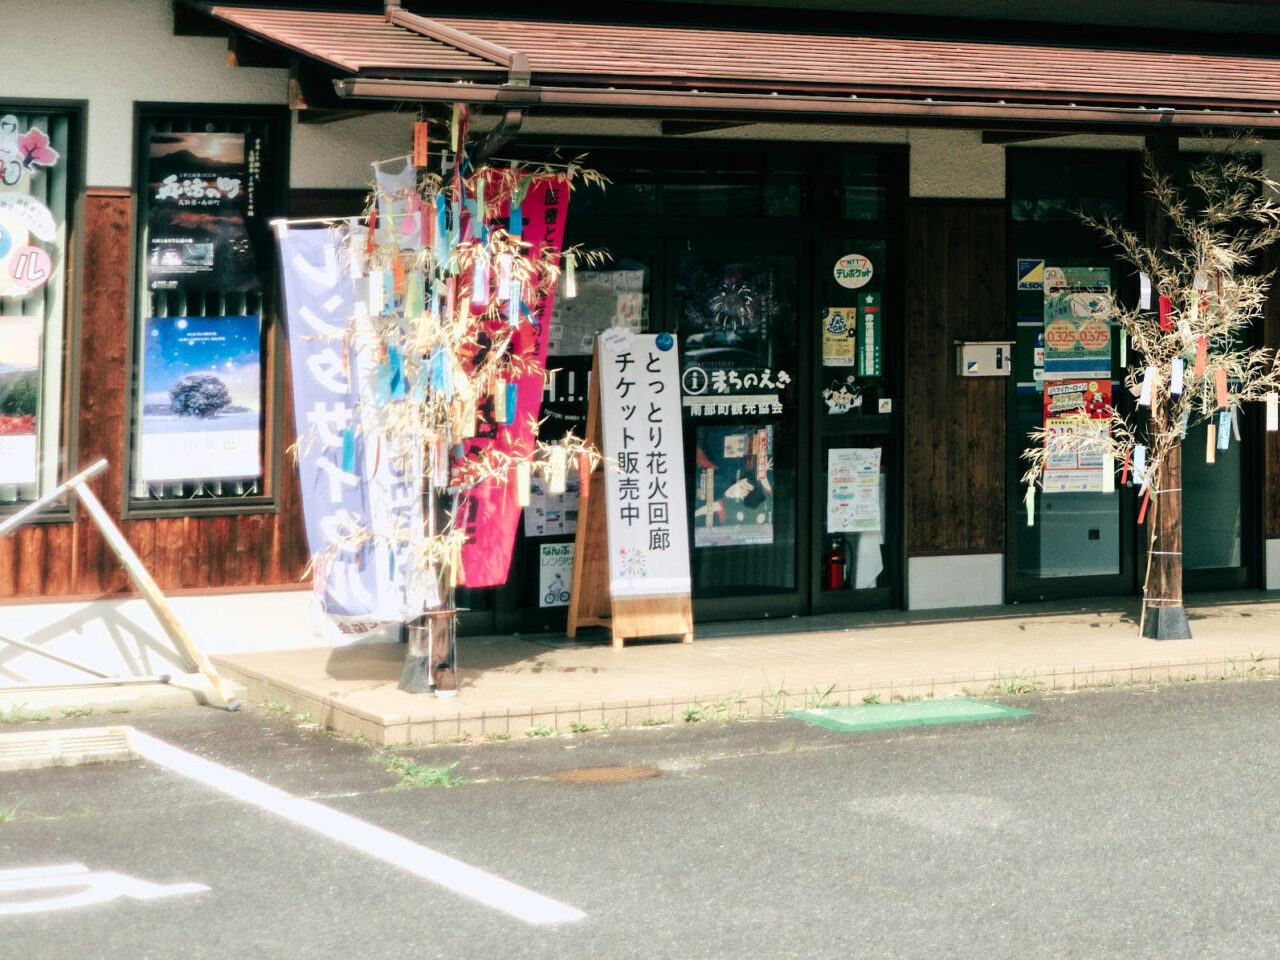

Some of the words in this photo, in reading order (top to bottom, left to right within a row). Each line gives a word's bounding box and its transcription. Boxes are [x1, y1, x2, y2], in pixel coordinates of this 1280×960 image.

[690, 401, 784, 418] 南部町観光協会
[710, 368, 793, 394] まちのえき
[614, 351, 640, 527] チケット販売中
[645, 351, 671, 552] とっとり花火回廊
